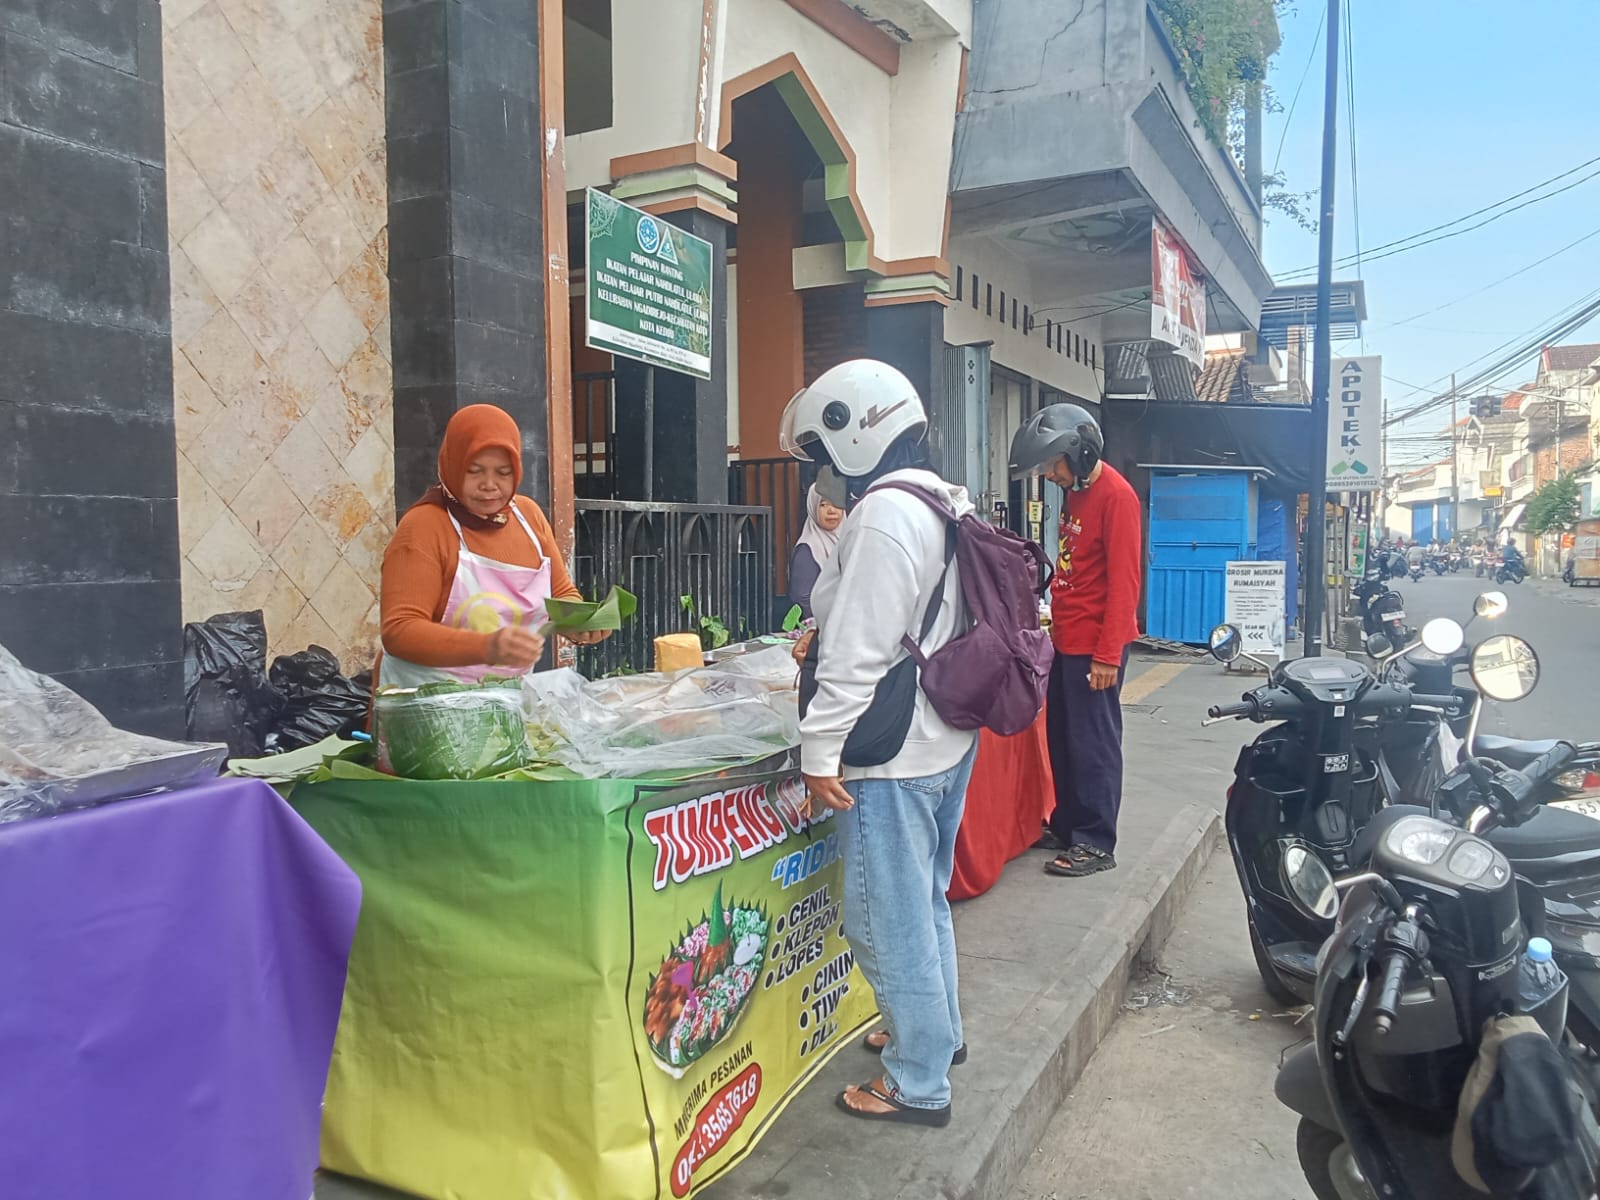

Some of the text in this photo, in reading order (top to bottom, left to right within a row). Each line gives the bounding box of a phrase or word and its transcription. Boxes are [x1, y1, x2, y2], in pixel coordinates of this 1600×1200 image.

[596, 270, 618, 289] IKATAN
[618, 279, 645, 299] PELAJAR
[645, 289, 664, 305] PUTRI
[606, 257, 628, 276] IKATAN
[628, 267, 655, 286] PELAJAR
[630, 251, 684, 281] PIMPINAN RANTING
[639, 319, 675, 339] KOTA KEDIRI
[1340, 360, 1363, 447] APOTEK
[644, 783, 787, 890] TUMPENG
[789, 885, 830, 928] CENIL
[777, 935, 824, 982] LOPES
[710, 1041, 753, 1089] PESANAN
